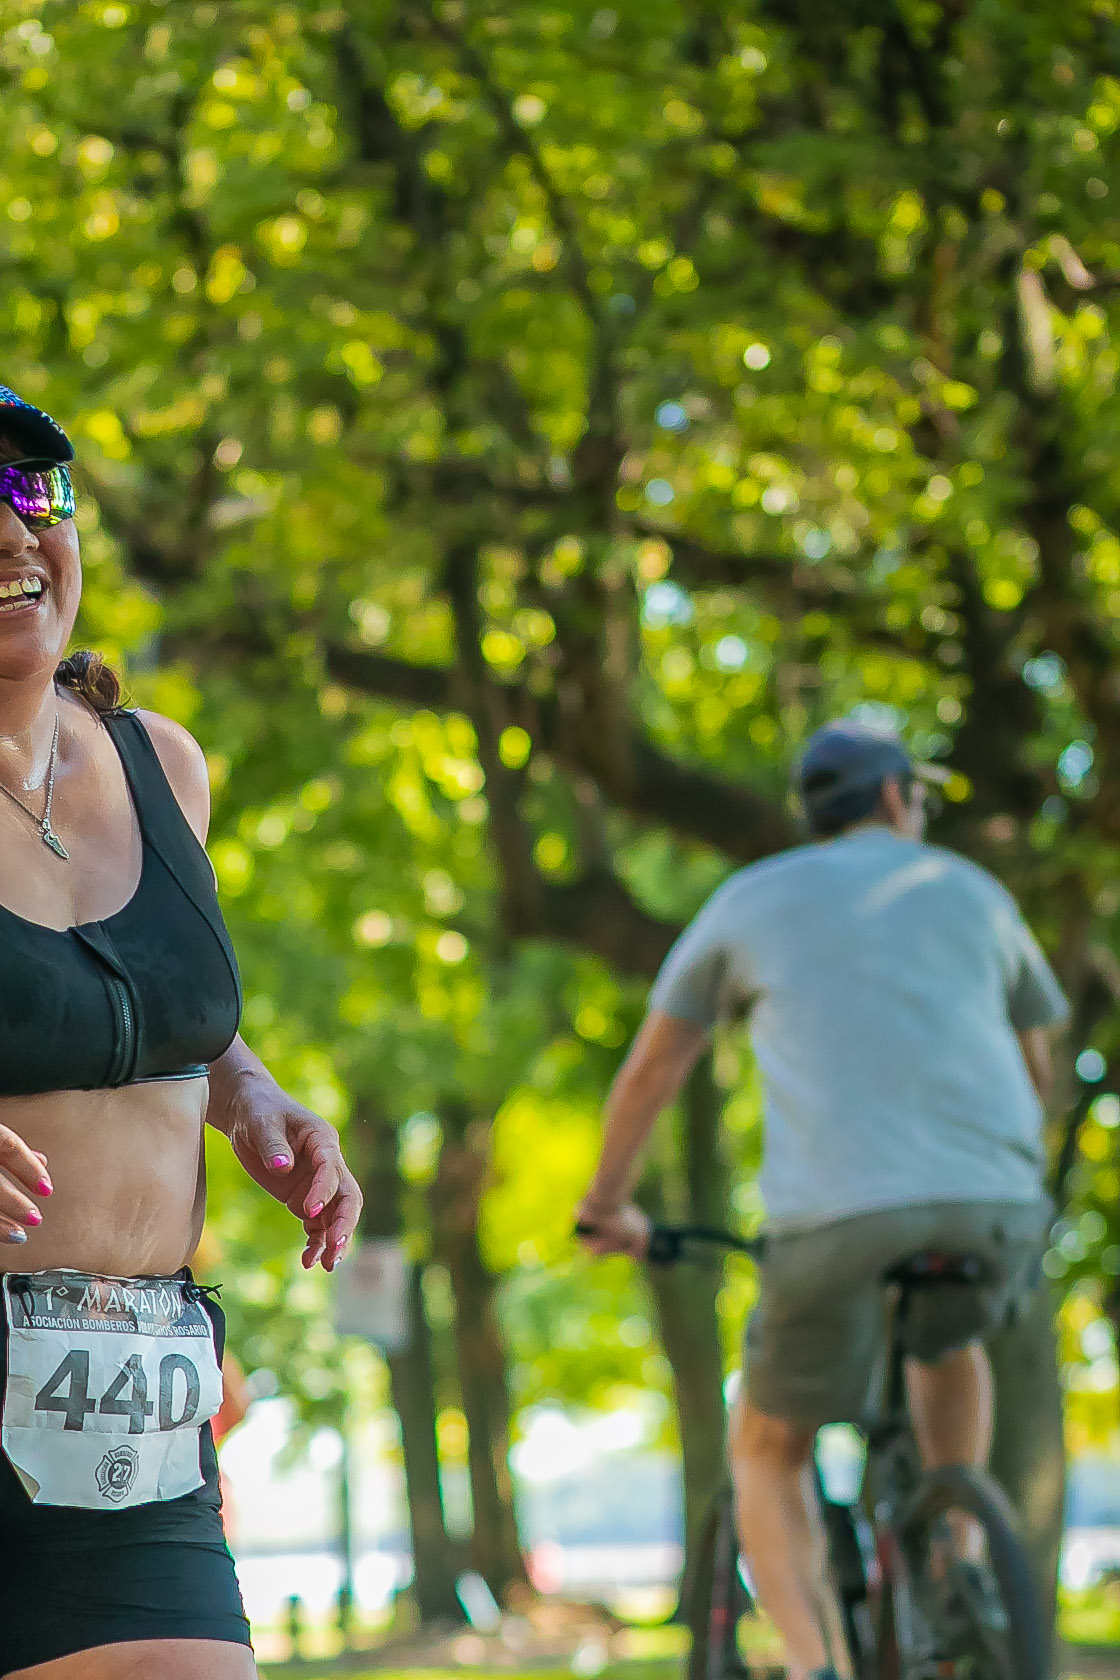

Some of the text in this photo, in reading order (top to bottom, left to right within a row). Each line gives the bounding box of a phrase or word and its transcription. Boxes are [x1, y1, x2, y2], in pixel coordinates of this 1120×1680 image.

[77, 1283, 182, 1319] MARATÓN
[82, 1318, 135, 1332] BOMBEROS
[173, 1324, 207, 1337] ROSARIO
[34, 1349, 201, 1435] 440
[111, 1462, 131, 1482] 27
